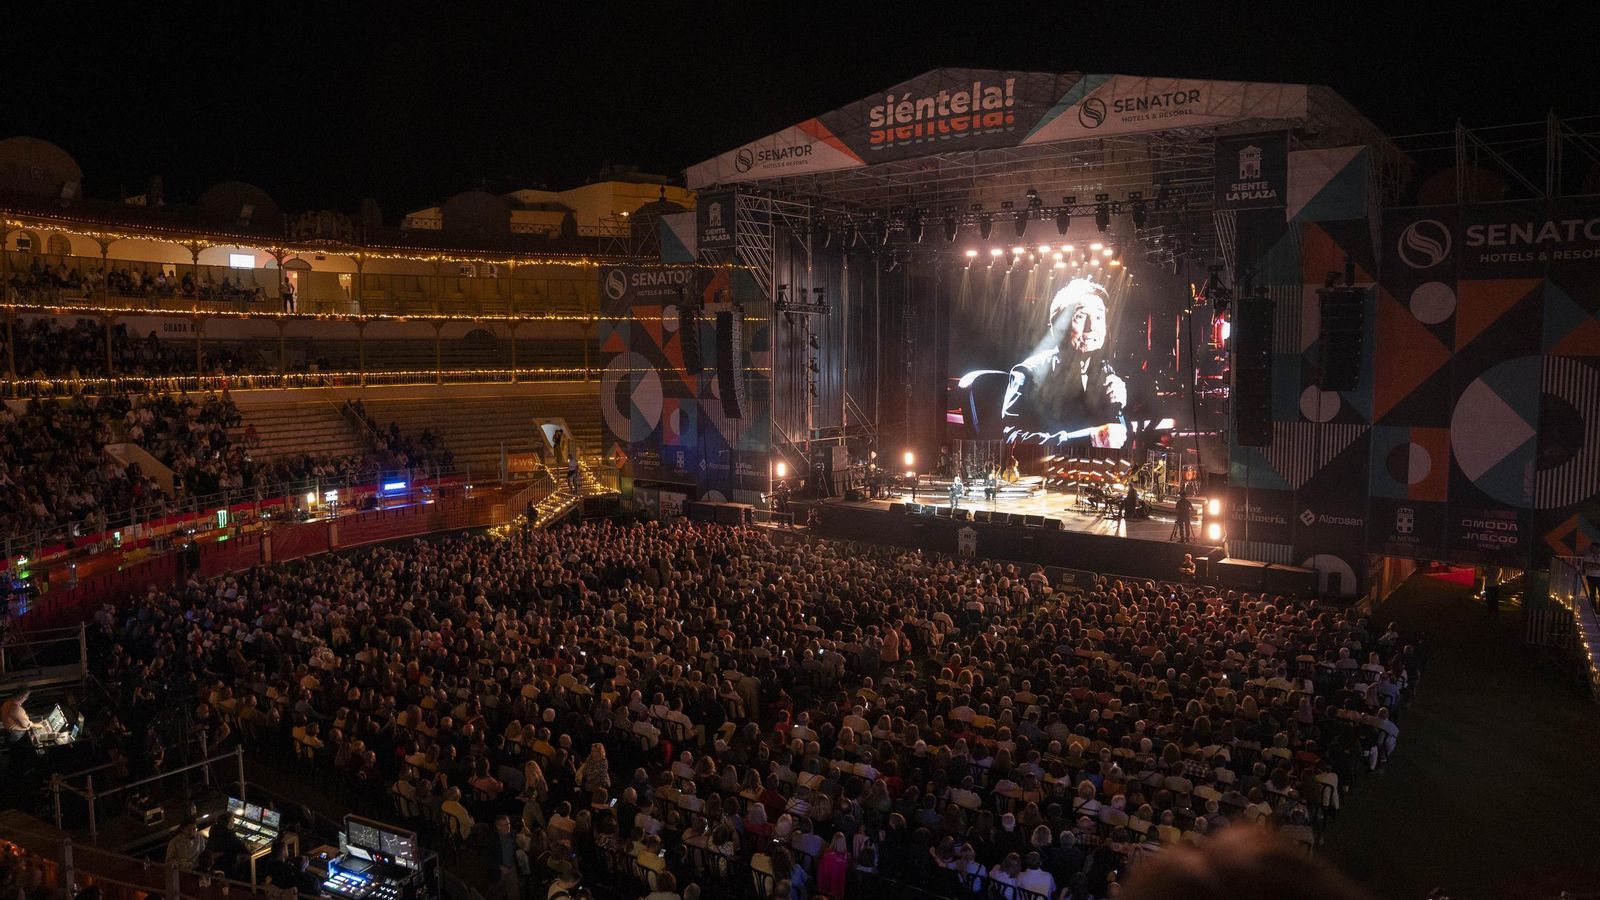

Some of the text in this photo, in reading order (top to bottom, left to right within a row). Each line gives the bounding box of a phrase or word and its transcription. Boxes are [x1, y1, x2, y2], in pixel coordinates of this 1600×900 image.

[869, 78, 1016, 128] siéntela!
[1114, 89, 1200, 113] SENATOR
[1122, 114, 1150, 123] HOTELS
[1160, 109, 1193, 118] RESORTS
[758, 144, 813, 161] SENATOR
[1231, 181, 1269, 192] SIENTE
[1226, 189, 1277, 201] LA PLAZA
[1480, 252, 1534, 263] HOTELS
[1538, 251, 1548, 261] &
[1461, 519, 1518, 531] OMODA
[1461, 532, 1518, 544] JAECOO
